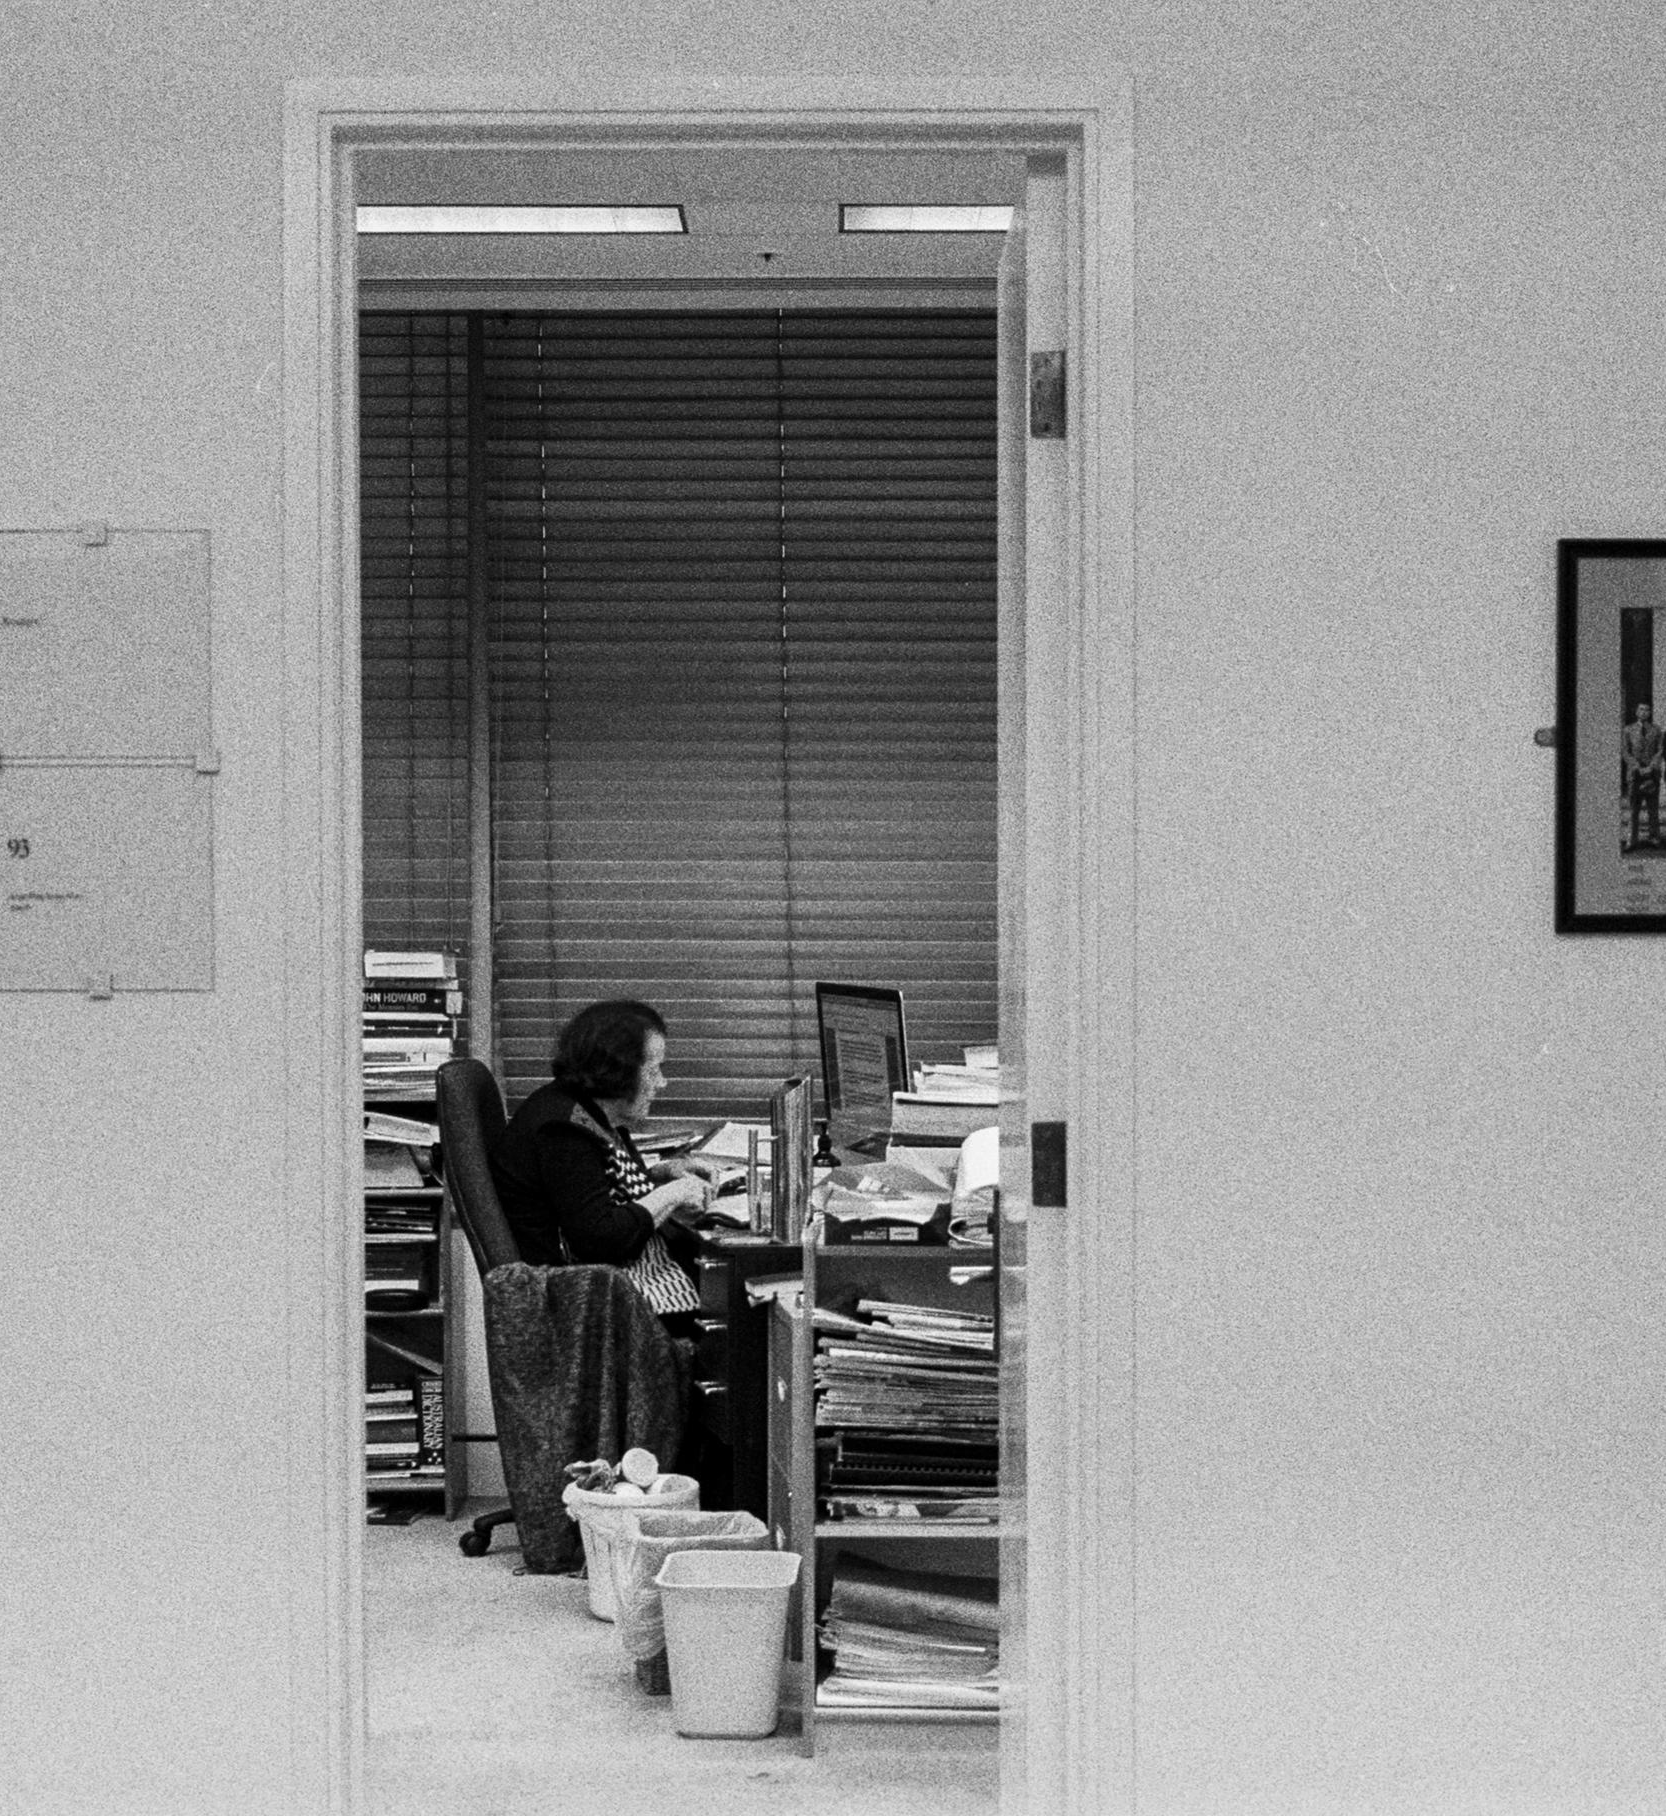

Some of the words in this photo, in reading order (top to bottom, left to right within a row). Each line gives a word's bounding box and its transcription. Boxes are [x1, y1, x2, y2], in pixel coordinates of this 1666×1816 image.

[7, 838, 30, 859] 93
[383, 992, 426, 1003] HOWARD
[422, 1394, 434, 1448] DICTIONARY
[432, 1394, 444, 1449] AUSTRALIAN
